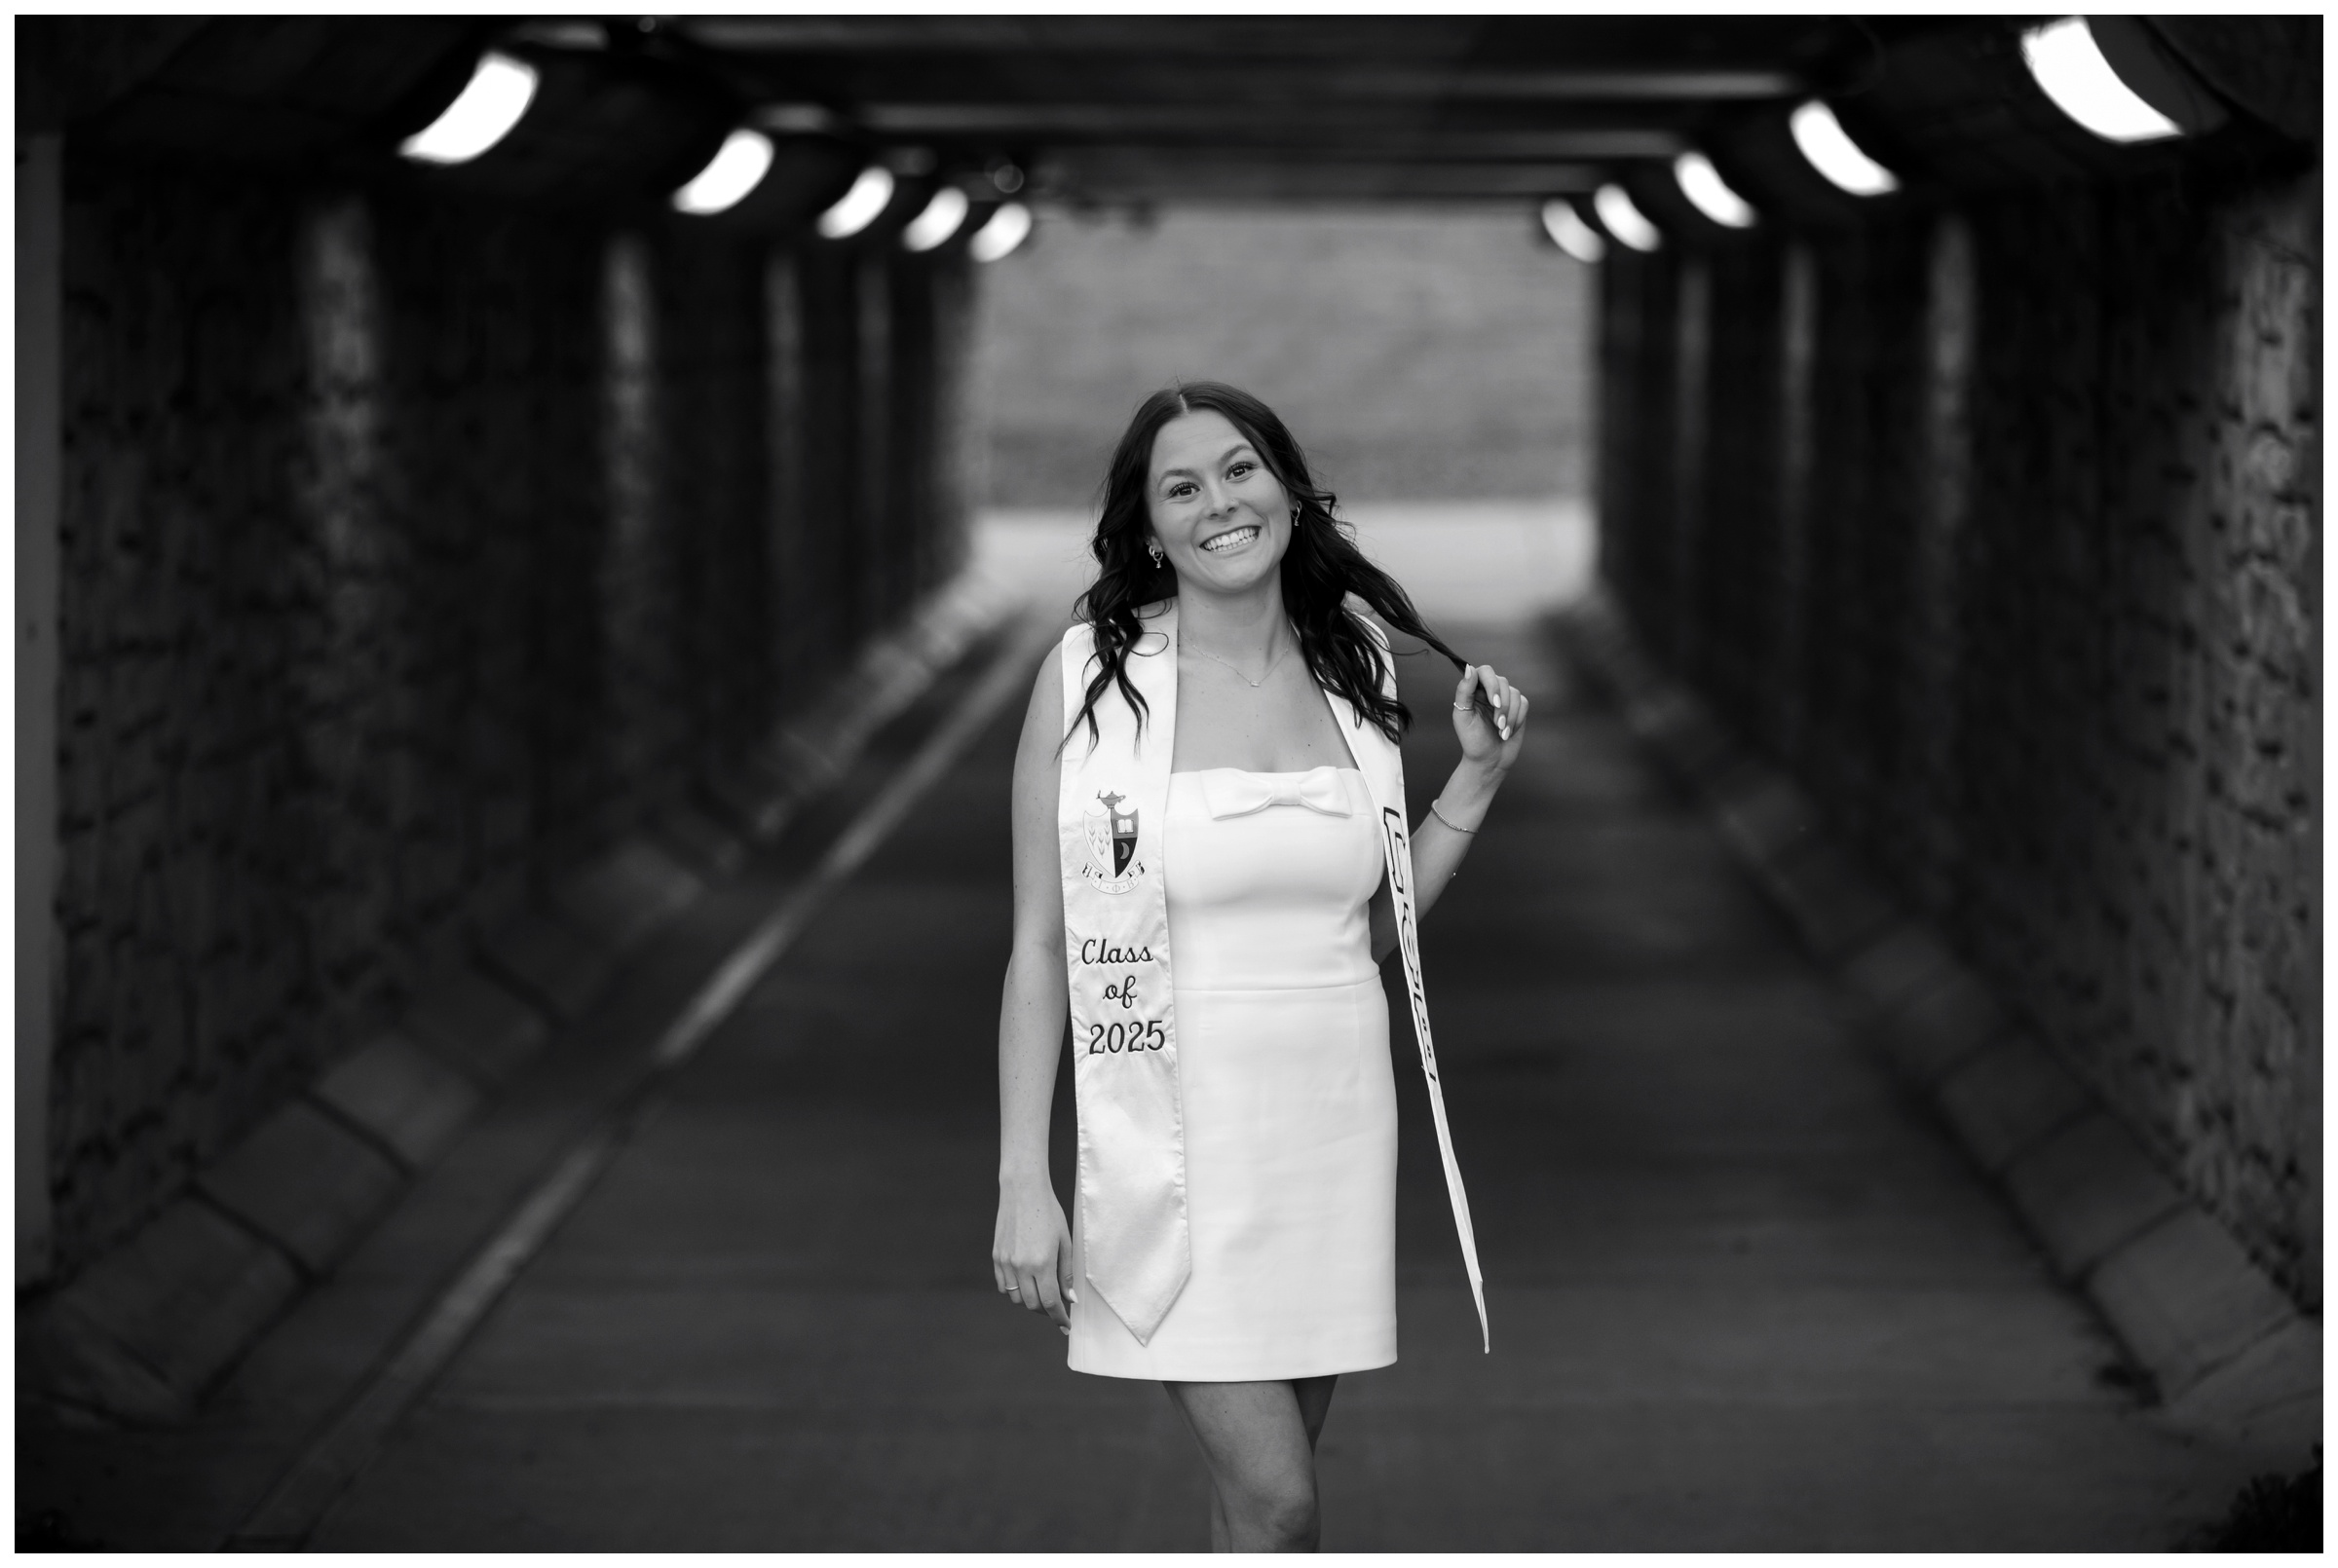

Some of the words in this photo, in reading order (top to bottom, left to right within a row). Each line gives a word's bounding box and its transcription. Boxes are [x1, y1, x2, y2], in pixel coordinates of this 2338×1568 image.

[1081, 938, 1153, 965] Class
[1102, 975, 1138, 1009] of
[1089, 1020, 1165, 1055] 2025
